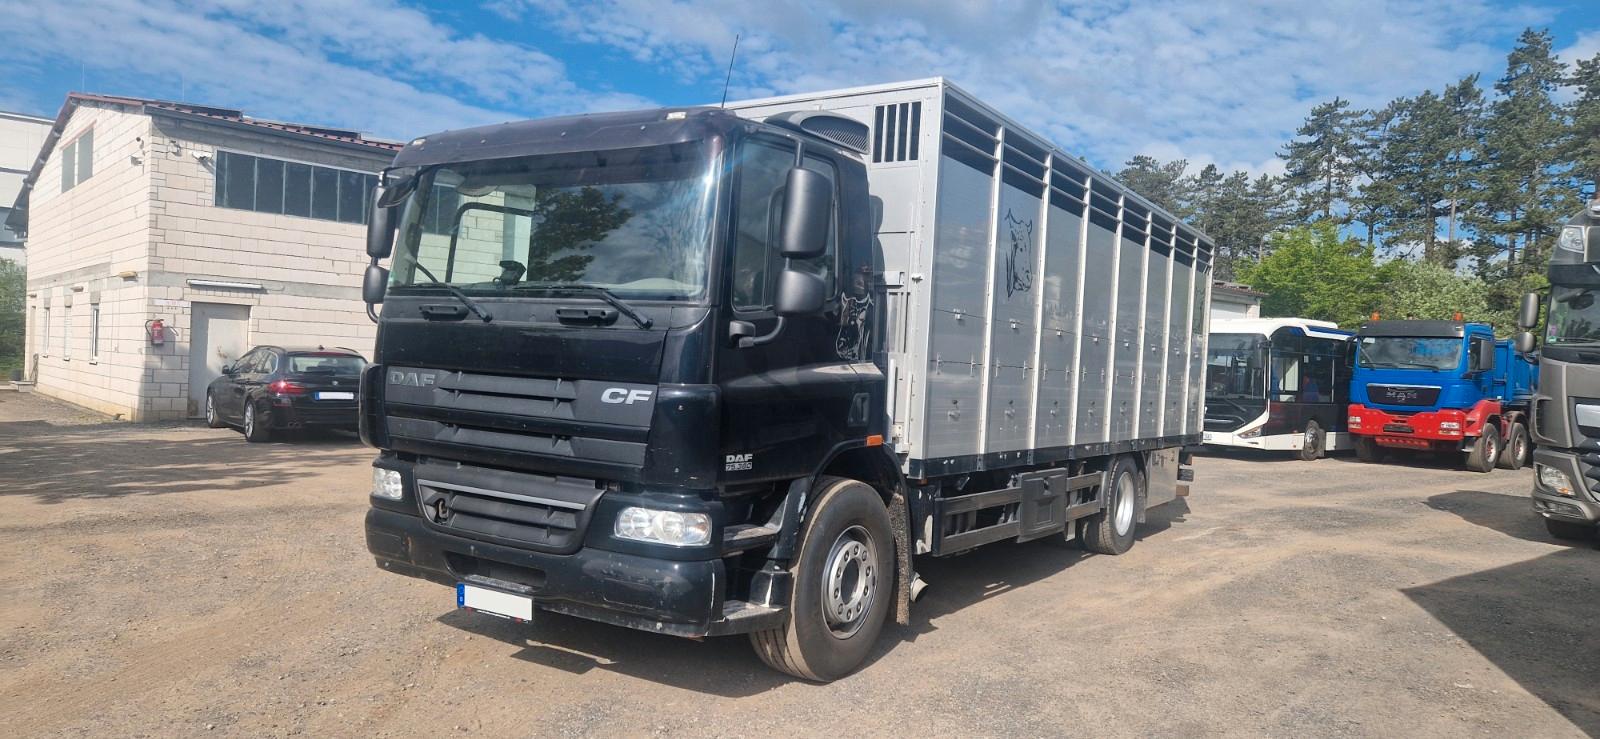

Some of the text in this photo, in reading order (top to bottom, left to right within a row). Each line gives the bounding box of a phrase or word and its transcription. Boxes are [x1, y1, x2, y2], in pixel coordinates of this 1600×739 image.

[390, 371, 435, 387] DAF
[601, 388, 653, 405] CF
[726, 453, 753, 463] DAF
